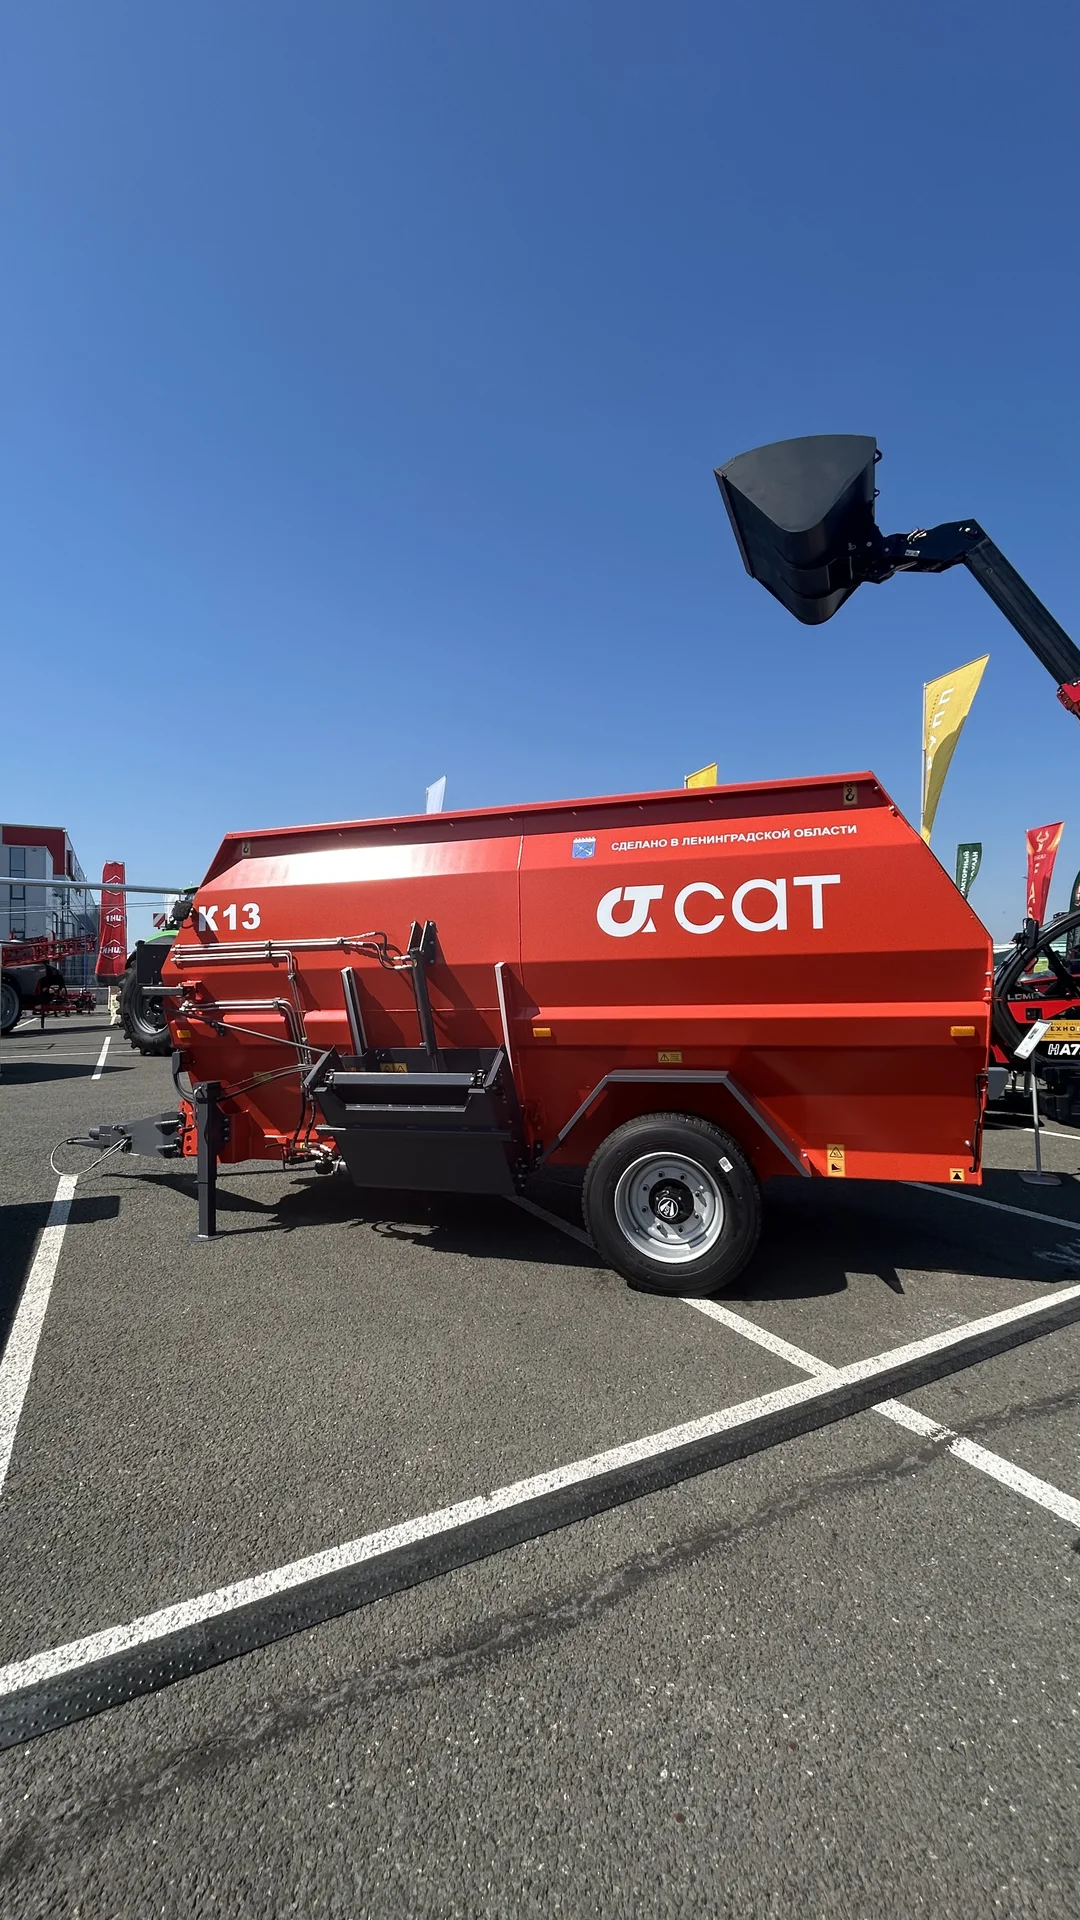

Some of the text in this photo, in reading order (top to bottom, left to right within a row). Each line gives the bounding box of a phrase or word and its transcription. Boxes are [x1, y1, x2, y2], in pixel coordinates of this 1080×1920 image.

[611, 825, 857, 851] СДЕЛАНО В ЛЕНИНГРАДСКОЙ ОБЛАСТИ
